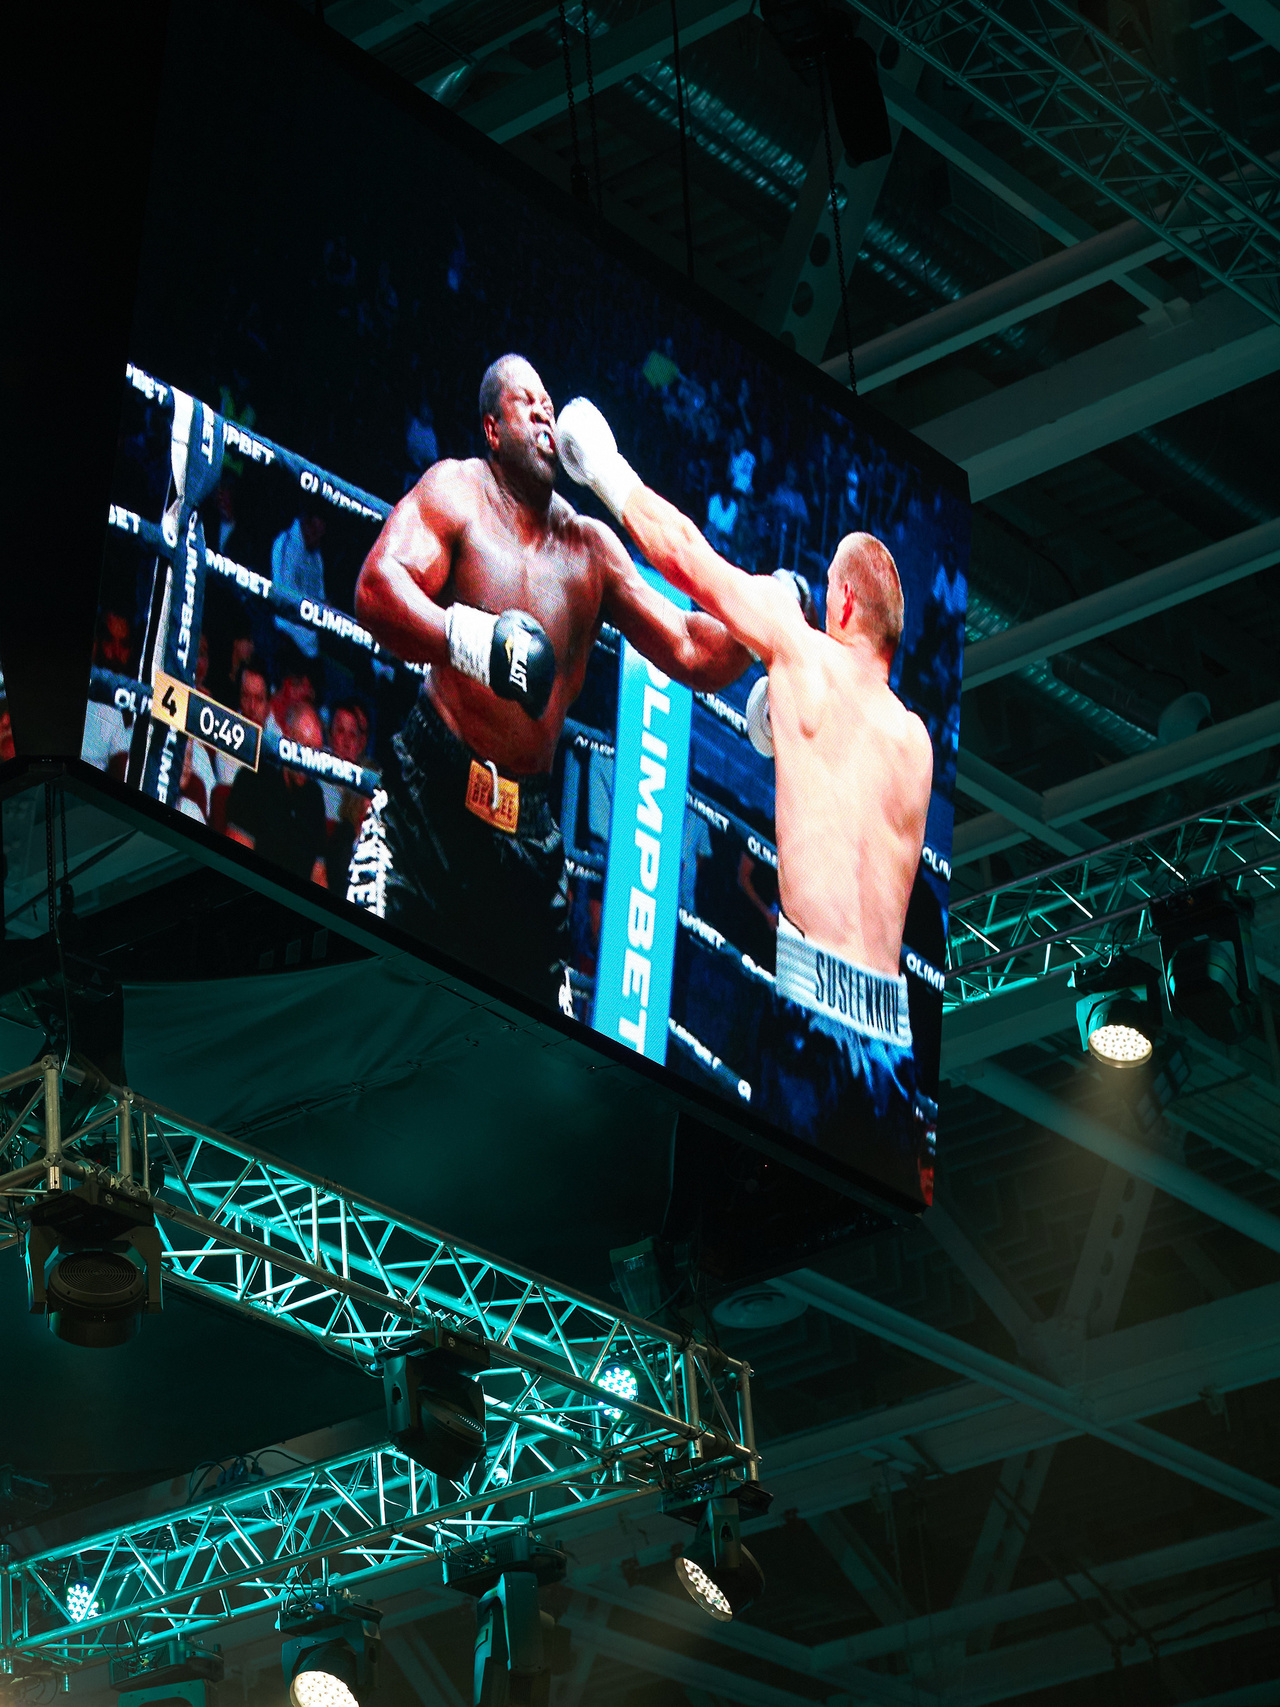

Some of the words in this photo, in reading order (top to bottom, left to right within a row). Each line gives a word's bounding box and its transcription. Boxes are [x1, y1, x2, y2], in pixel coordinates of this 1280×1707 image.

[177, 510, 199, 669] OLIMPBET
[161, 685, 177, 717] 4
[199, 706, 245, 751] 0:49
[278, 737, 363, 786] OLIMPBET
[815, 950, 899, 1036] SUSLENKOV
